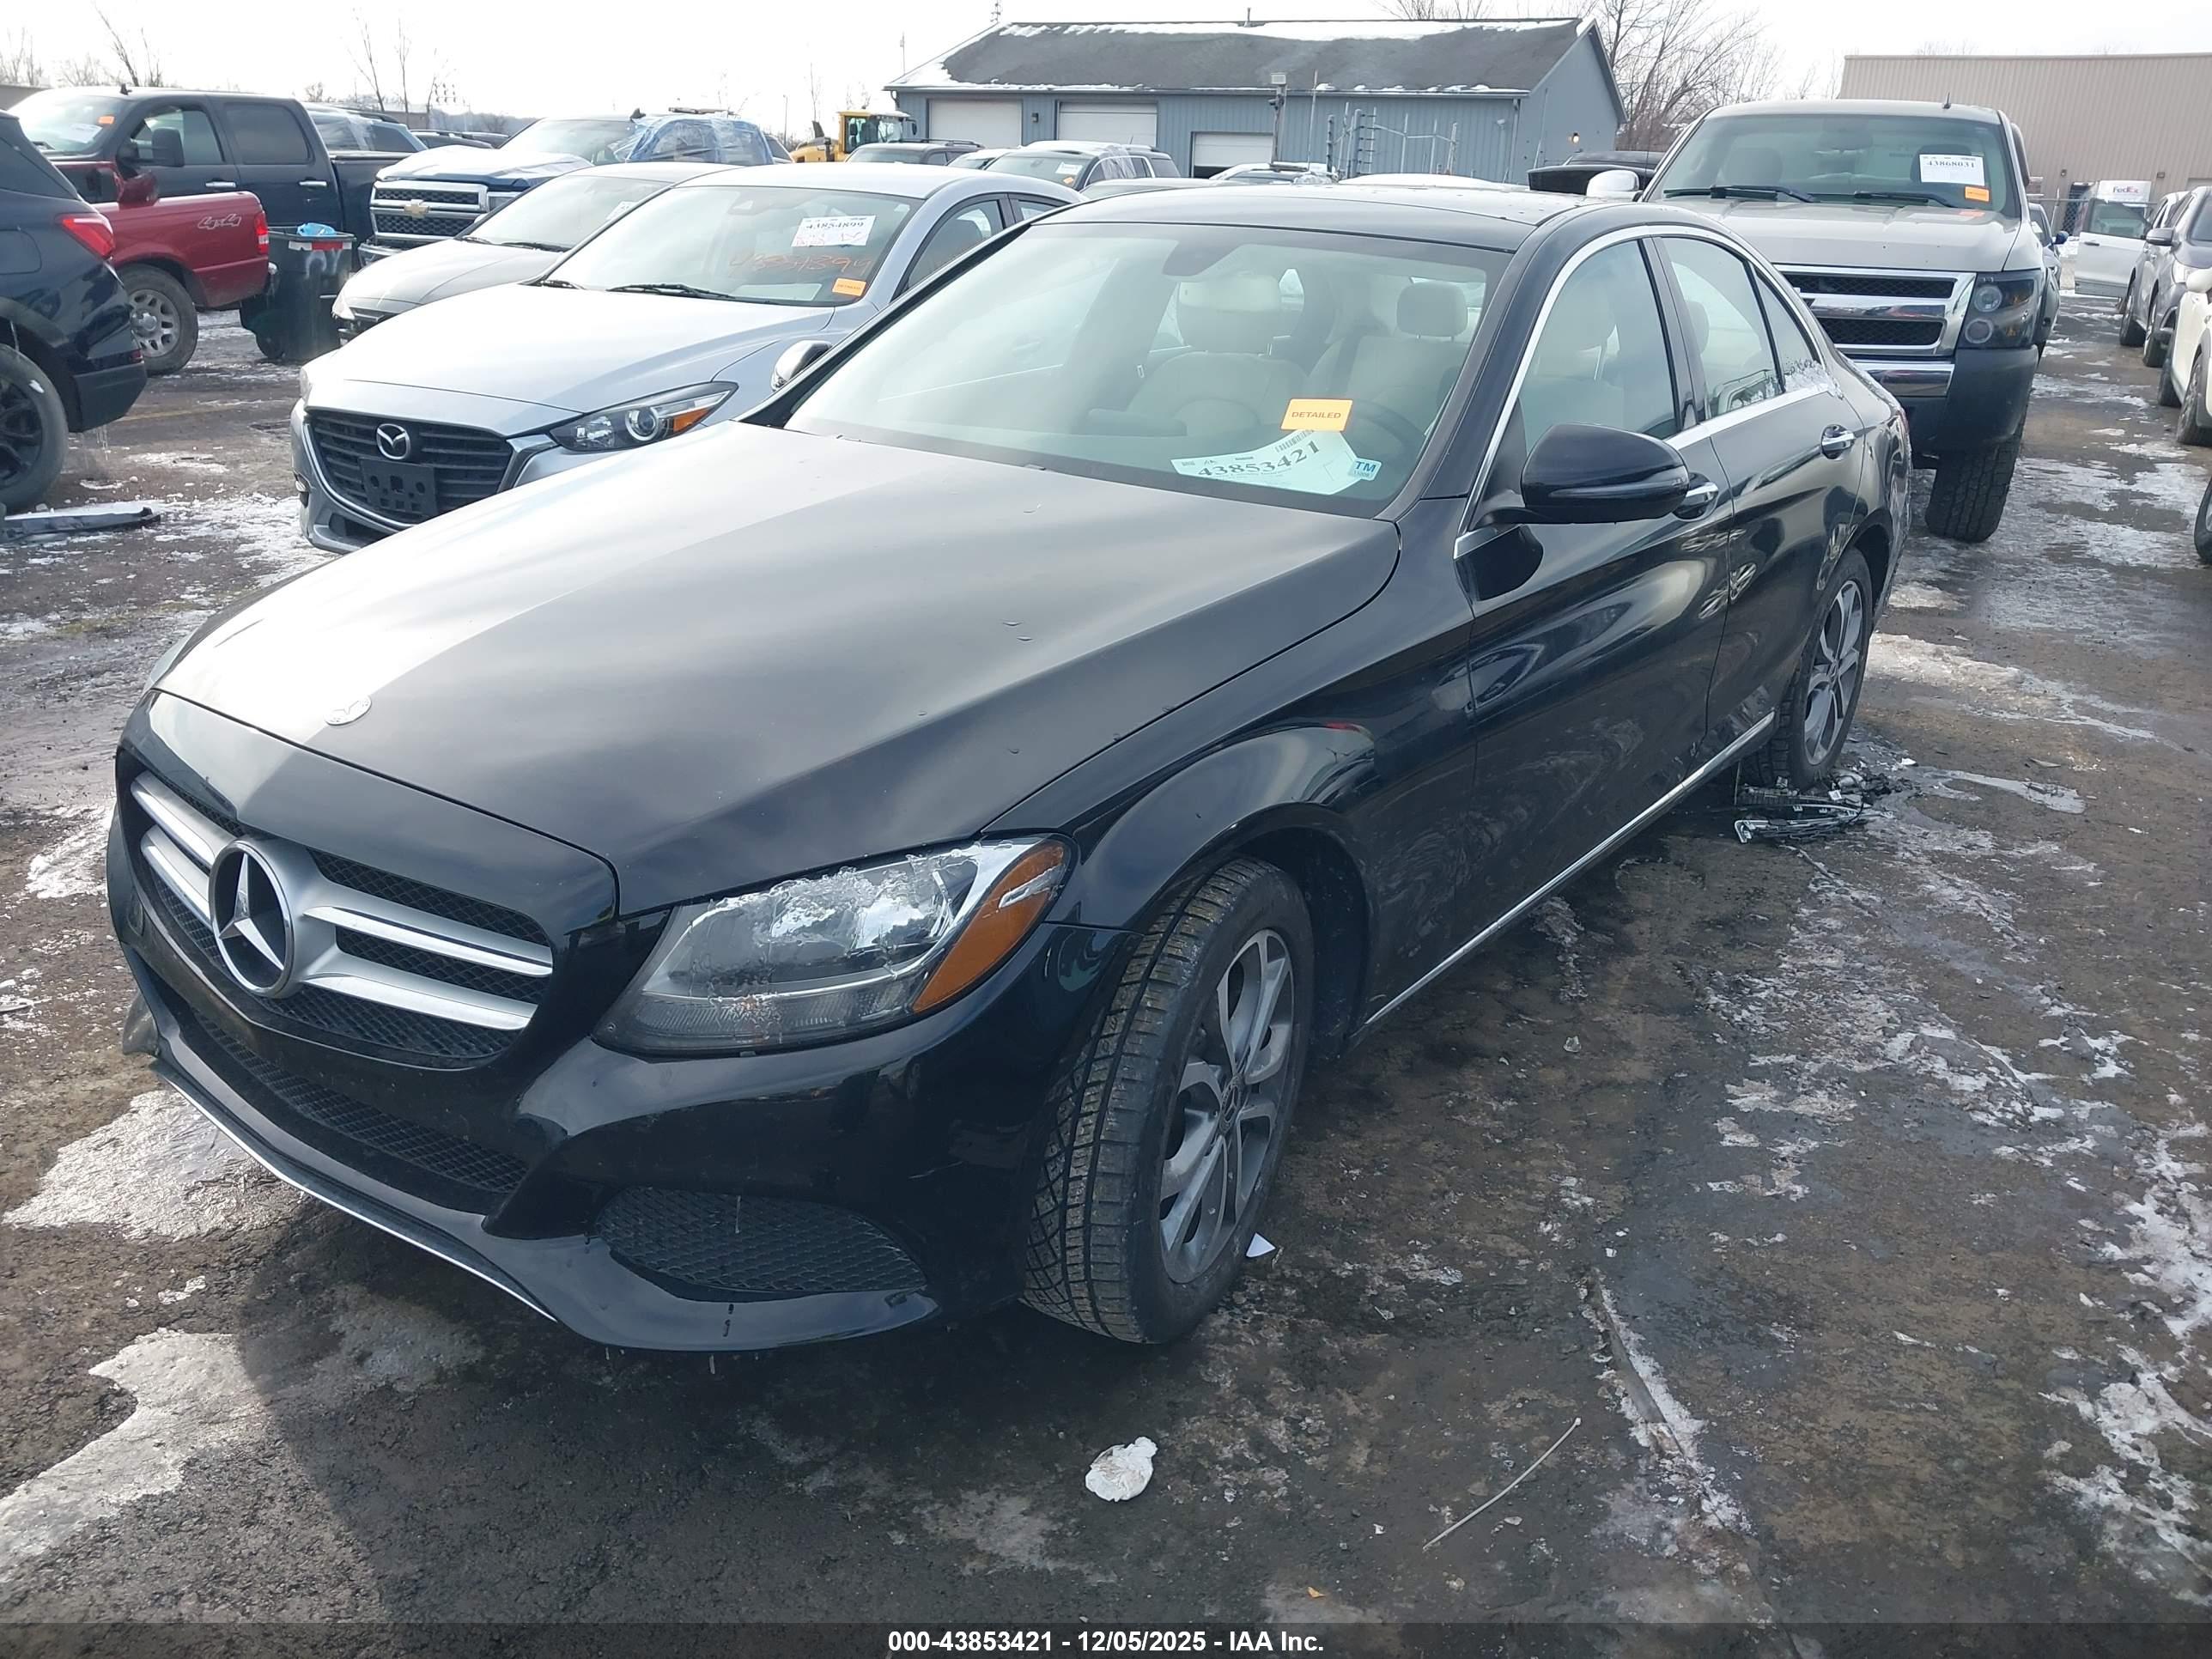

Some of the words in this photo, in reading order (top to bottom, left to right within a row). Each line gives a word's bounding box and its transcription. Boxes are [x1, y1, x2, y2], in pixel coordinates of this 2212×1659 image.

[198, 214, 241, 230] 4x4
[1198, 441, 1319, 476] 43853421
[1356, 460, 1376, 472] TM
